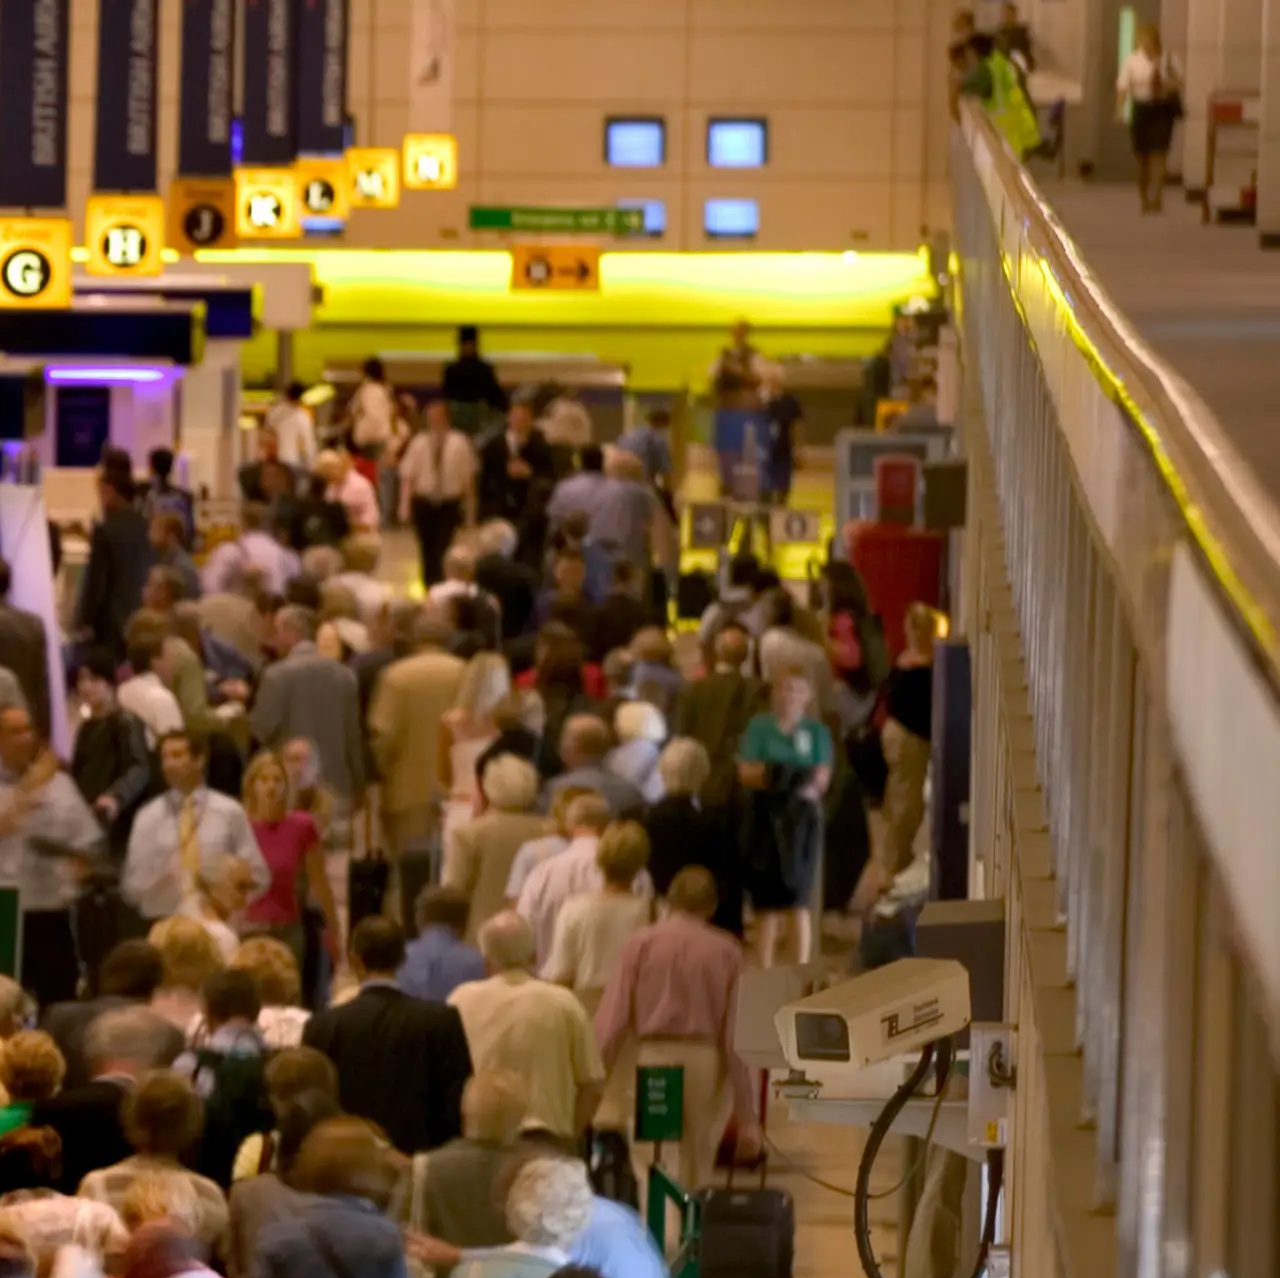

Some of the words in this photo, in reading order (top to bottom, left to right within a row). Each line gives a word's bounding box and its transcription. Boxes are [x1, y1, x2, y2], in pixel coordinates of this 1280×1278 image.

[195, 210, 213, 240] J
[107, 226, 142, 267] H
[6, 254, 43, 293] G
